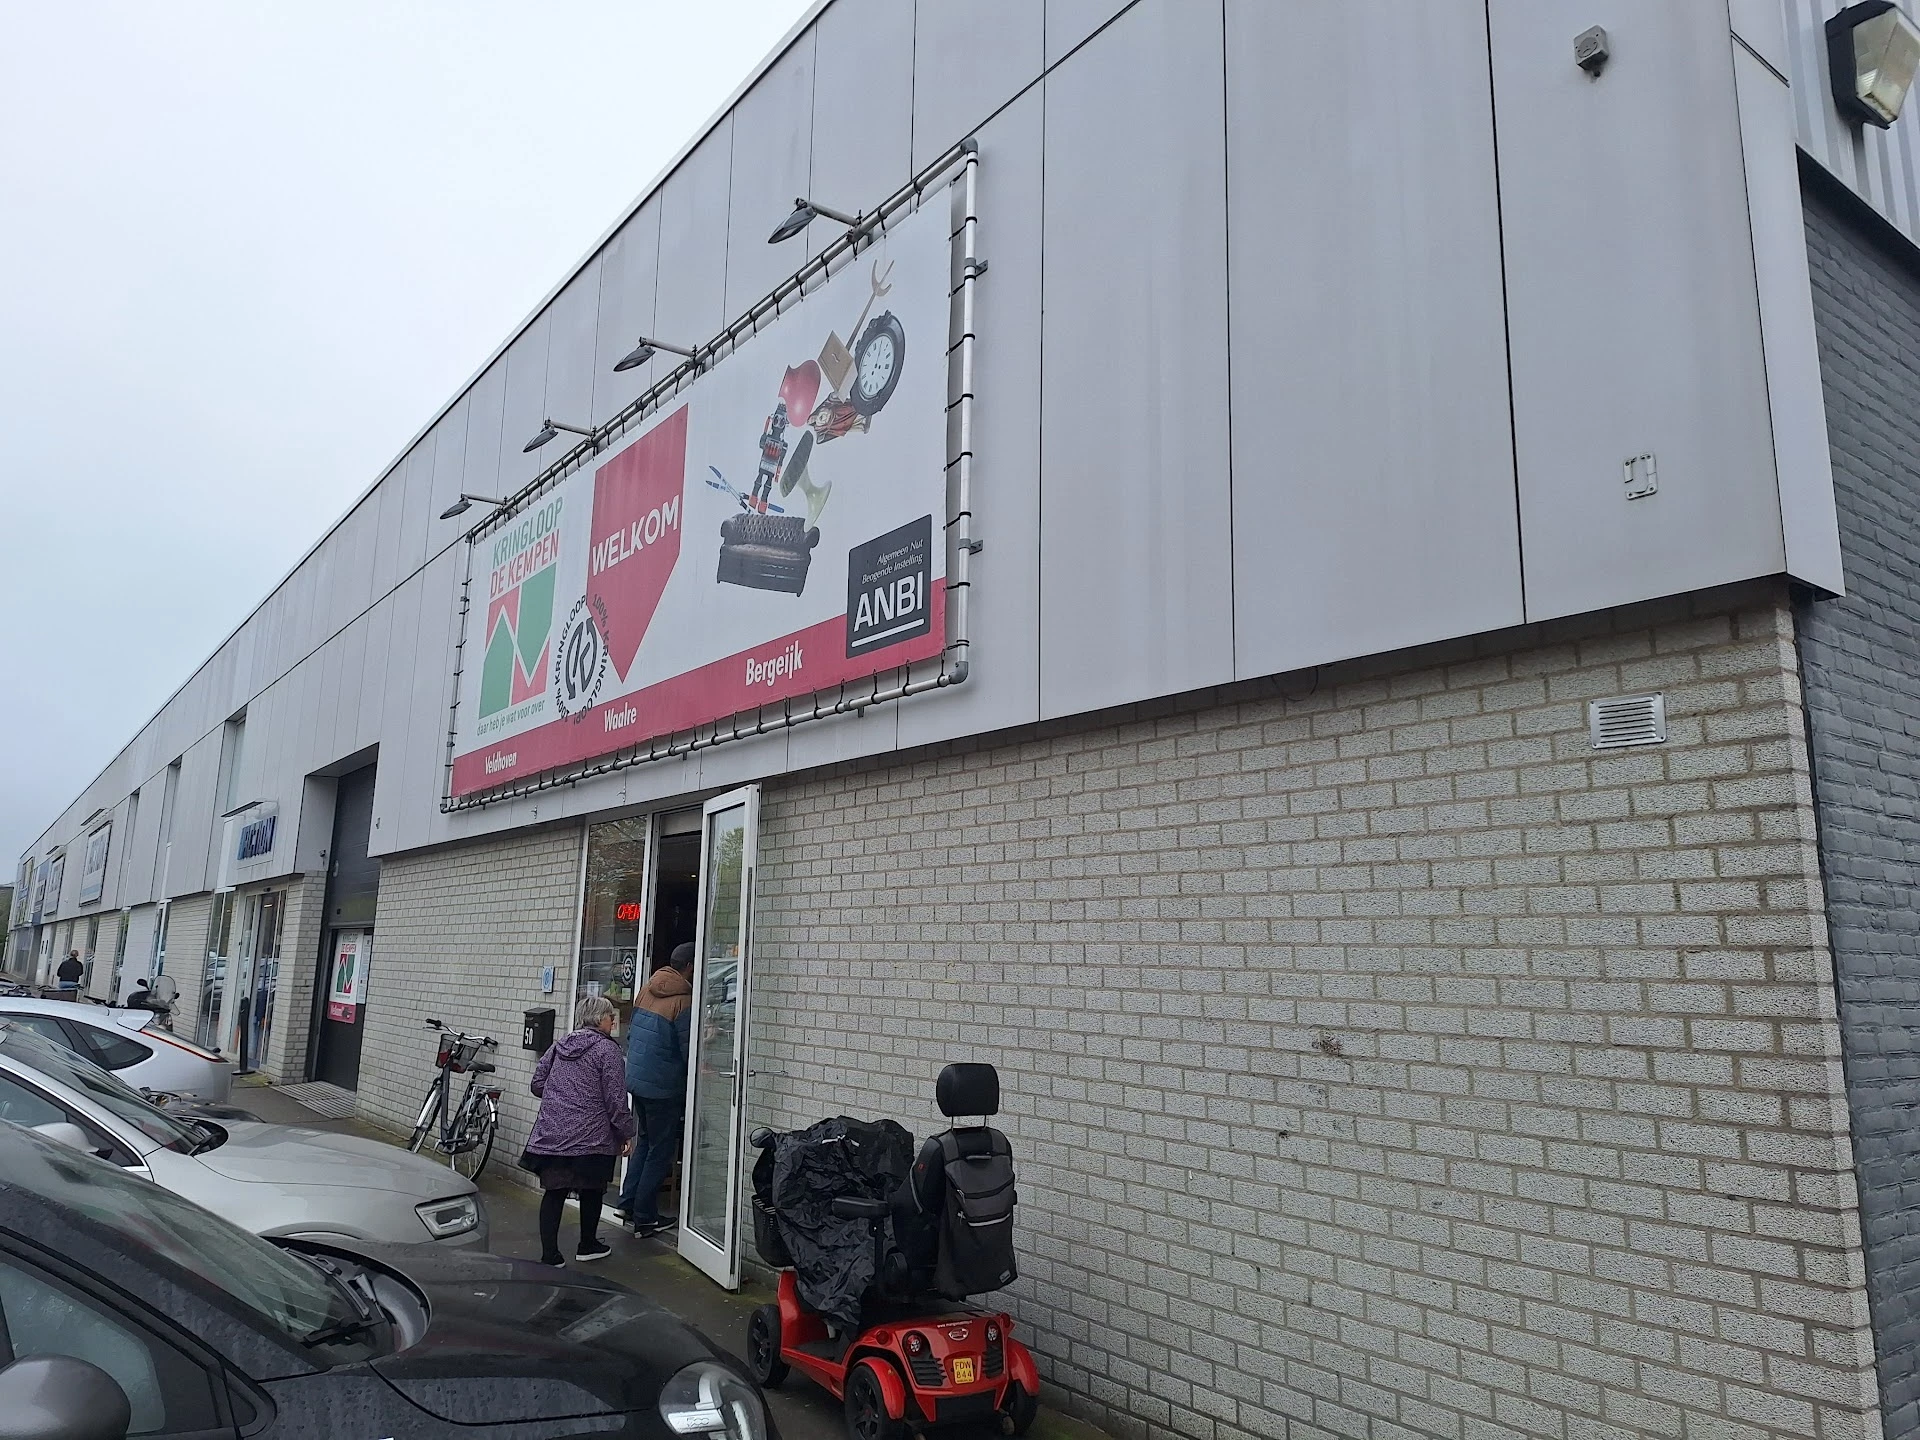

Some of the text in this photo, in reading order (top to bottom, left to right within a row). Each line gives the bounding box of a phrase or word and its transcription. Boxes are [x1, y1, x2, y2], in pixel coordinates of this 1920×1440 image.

[493, 496, 563, 569] KRINGLOOP
[592, 495, 680, 576] WELKOM
[490, 529, 560, 599] DE KEMPEN
[877, 538, 924, 566] Algemeen Nut
[861, 553, 924, 585] Beogende Instelling
[853, 571, 924, 632] ANBI
[745, 640, 804, 687] Bergeijk
[476, 699, 545, 736] daar heb je wat voor over
[603, 702, 637, 733] Waalre
[484, 751, 517, 775] Veldhoven
[617, 903, 641, 921] OPEN
[524, 1027, 534, 1045] 50
[954, 1360, 972, 1371] FDW
